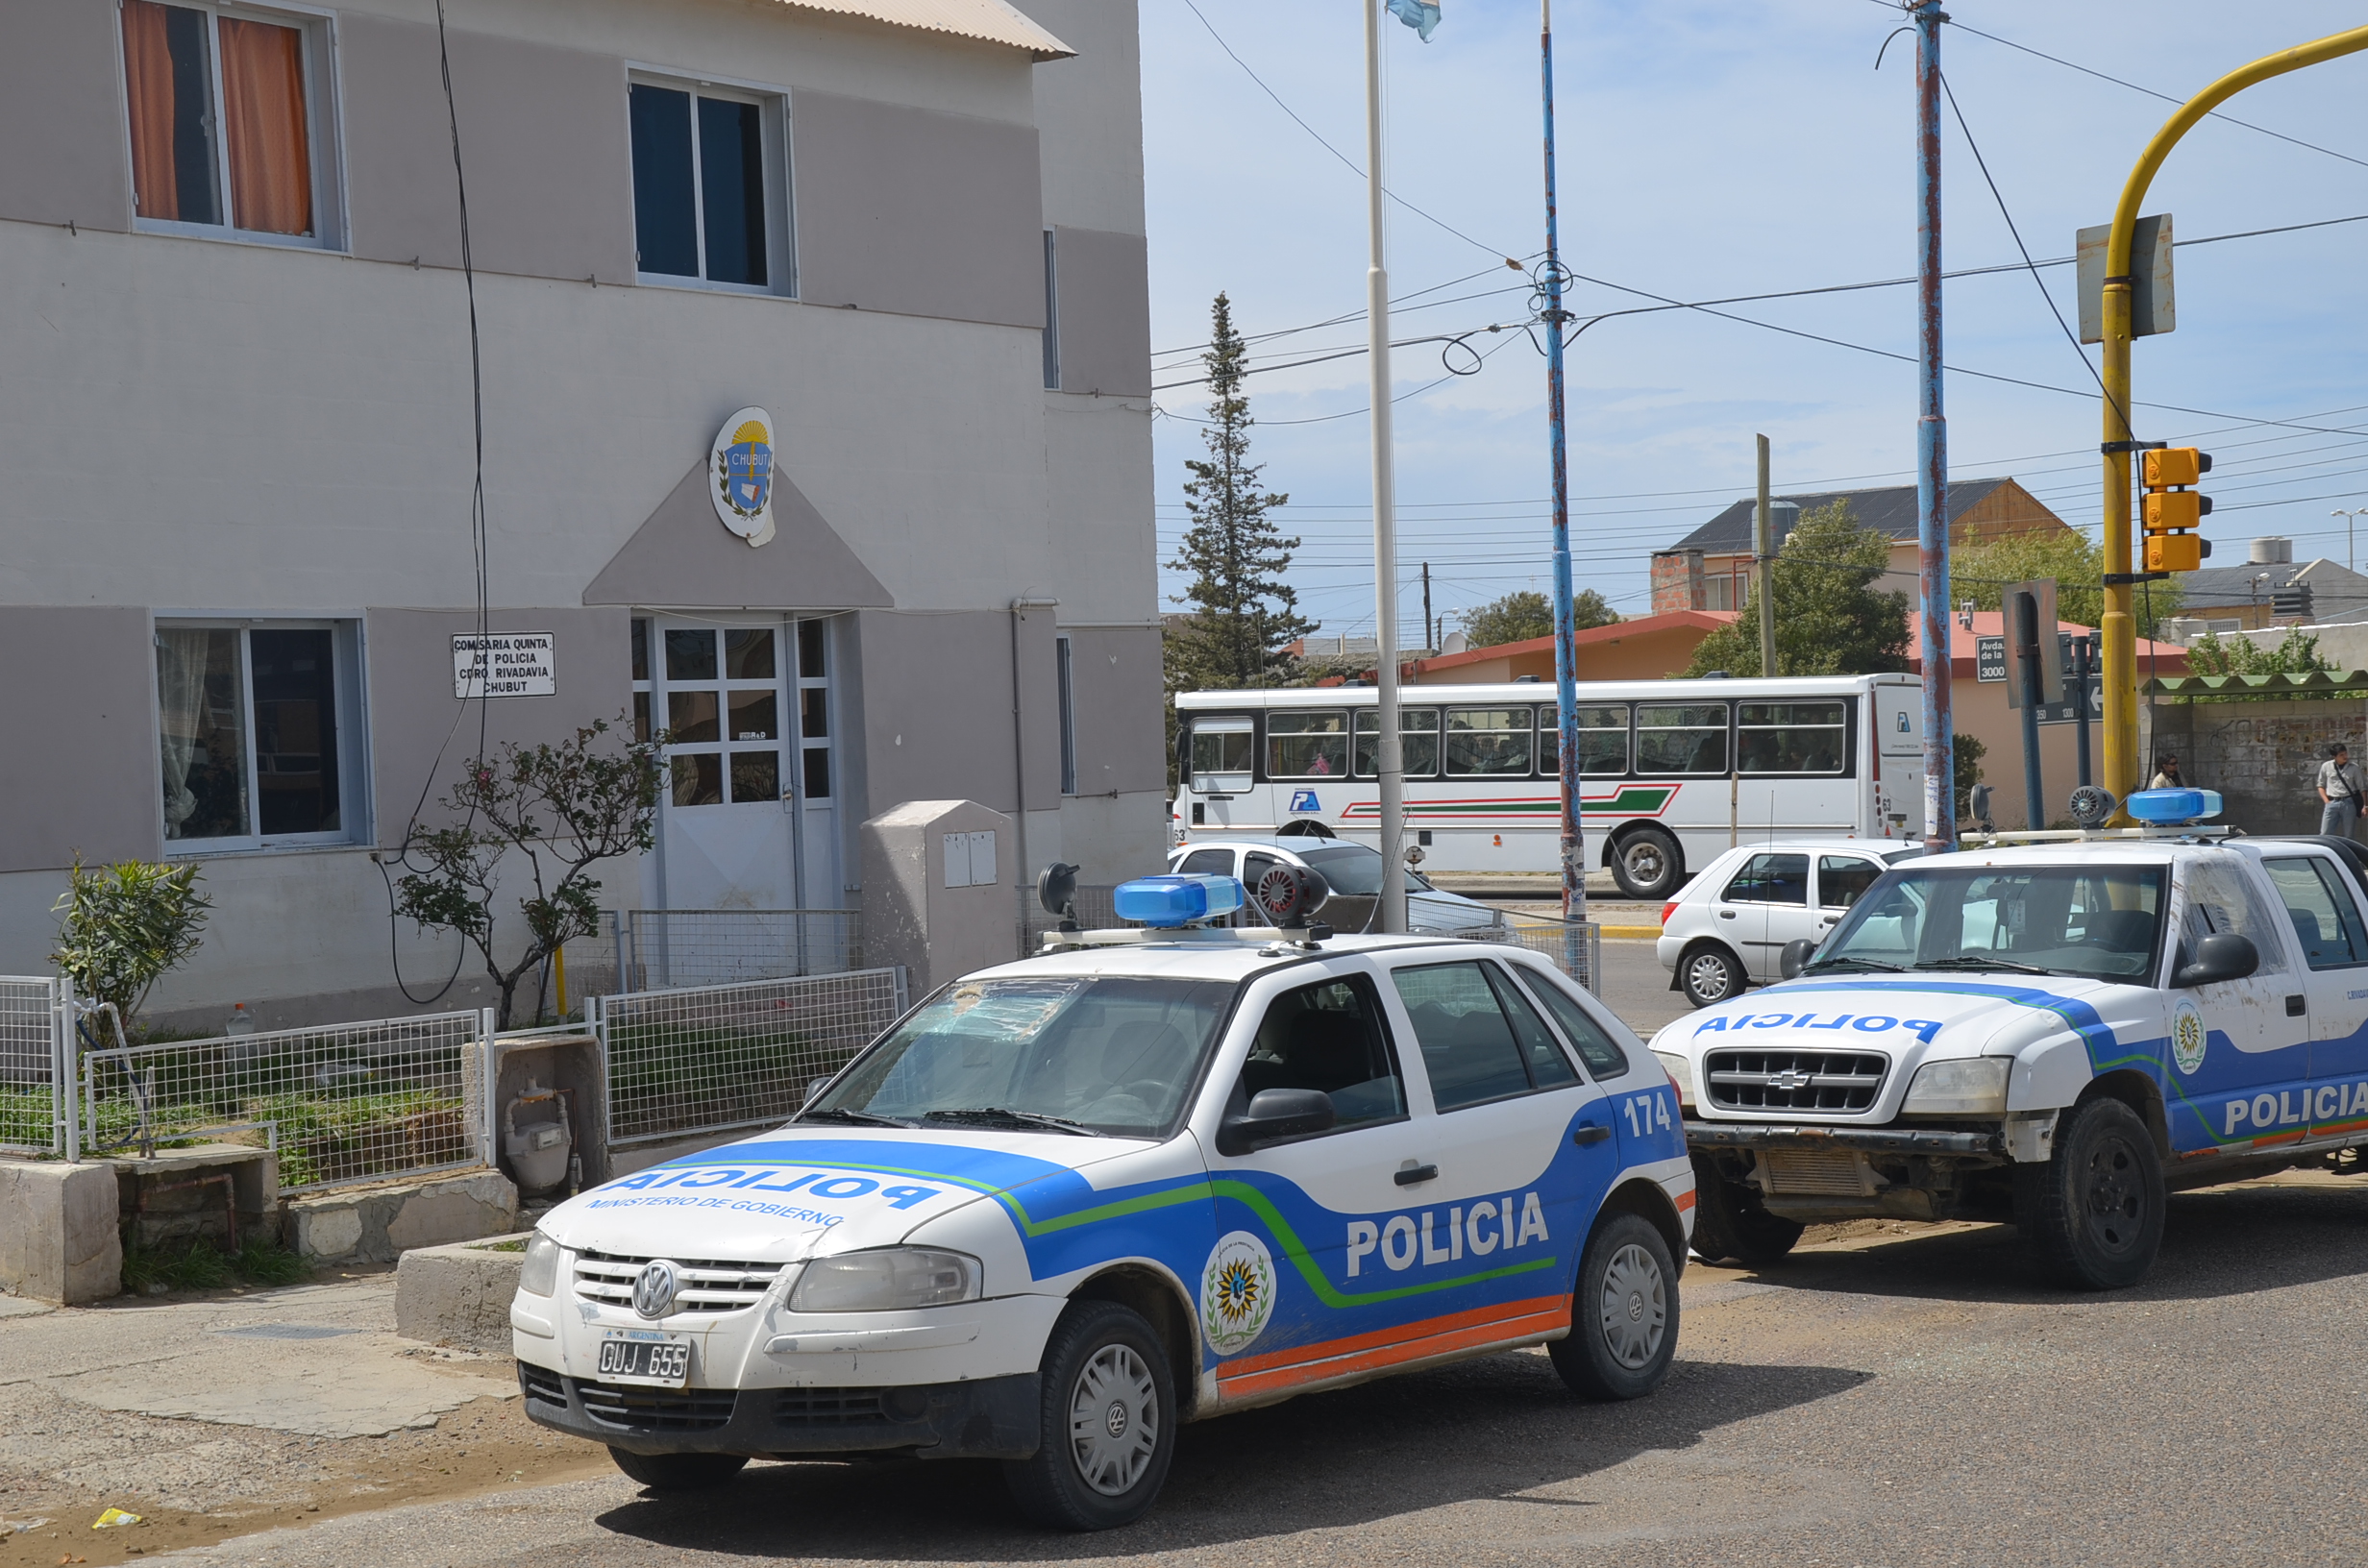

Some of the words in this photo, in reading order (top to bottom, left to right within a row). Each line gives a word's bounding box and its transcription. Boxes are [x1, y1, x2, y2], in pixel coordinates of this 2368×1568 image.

[731, 453, 768, 466] CHUBUT
[513, 638, 548, 650] QUINTA
[1981, 641, 2005, 650] Avda.
[475, 654, 489, 665] DE
[495, 652, 536, 664] POLICIA
[1981, 650, 1992, 660] de
[1993, 650, 2002, 659] la
[496, 666, 549, 678] RIVADAVIA
[1982, 666, 2006, 677] 3000
[483, 680, 528, 693] CHUBUT
[1883, 798, 1891, 812] 63
[1624, 1091, 1671, 1138] 174
[2225, 1082, 2368, 1136] POLICIA
[585, 1197, 700, 1209] MINISTERIO
[696, 1198, 732, 1209] DE
[730, 1200, 844, 1227] GOBIERNO
[1347, 1191, 1549, 1277] POLICIA
[628, 1331, 664, 1340] ARGENTINA
[601, 1342, 638, 1373] GUJ
[649, 1345, 686, 1377] 655
